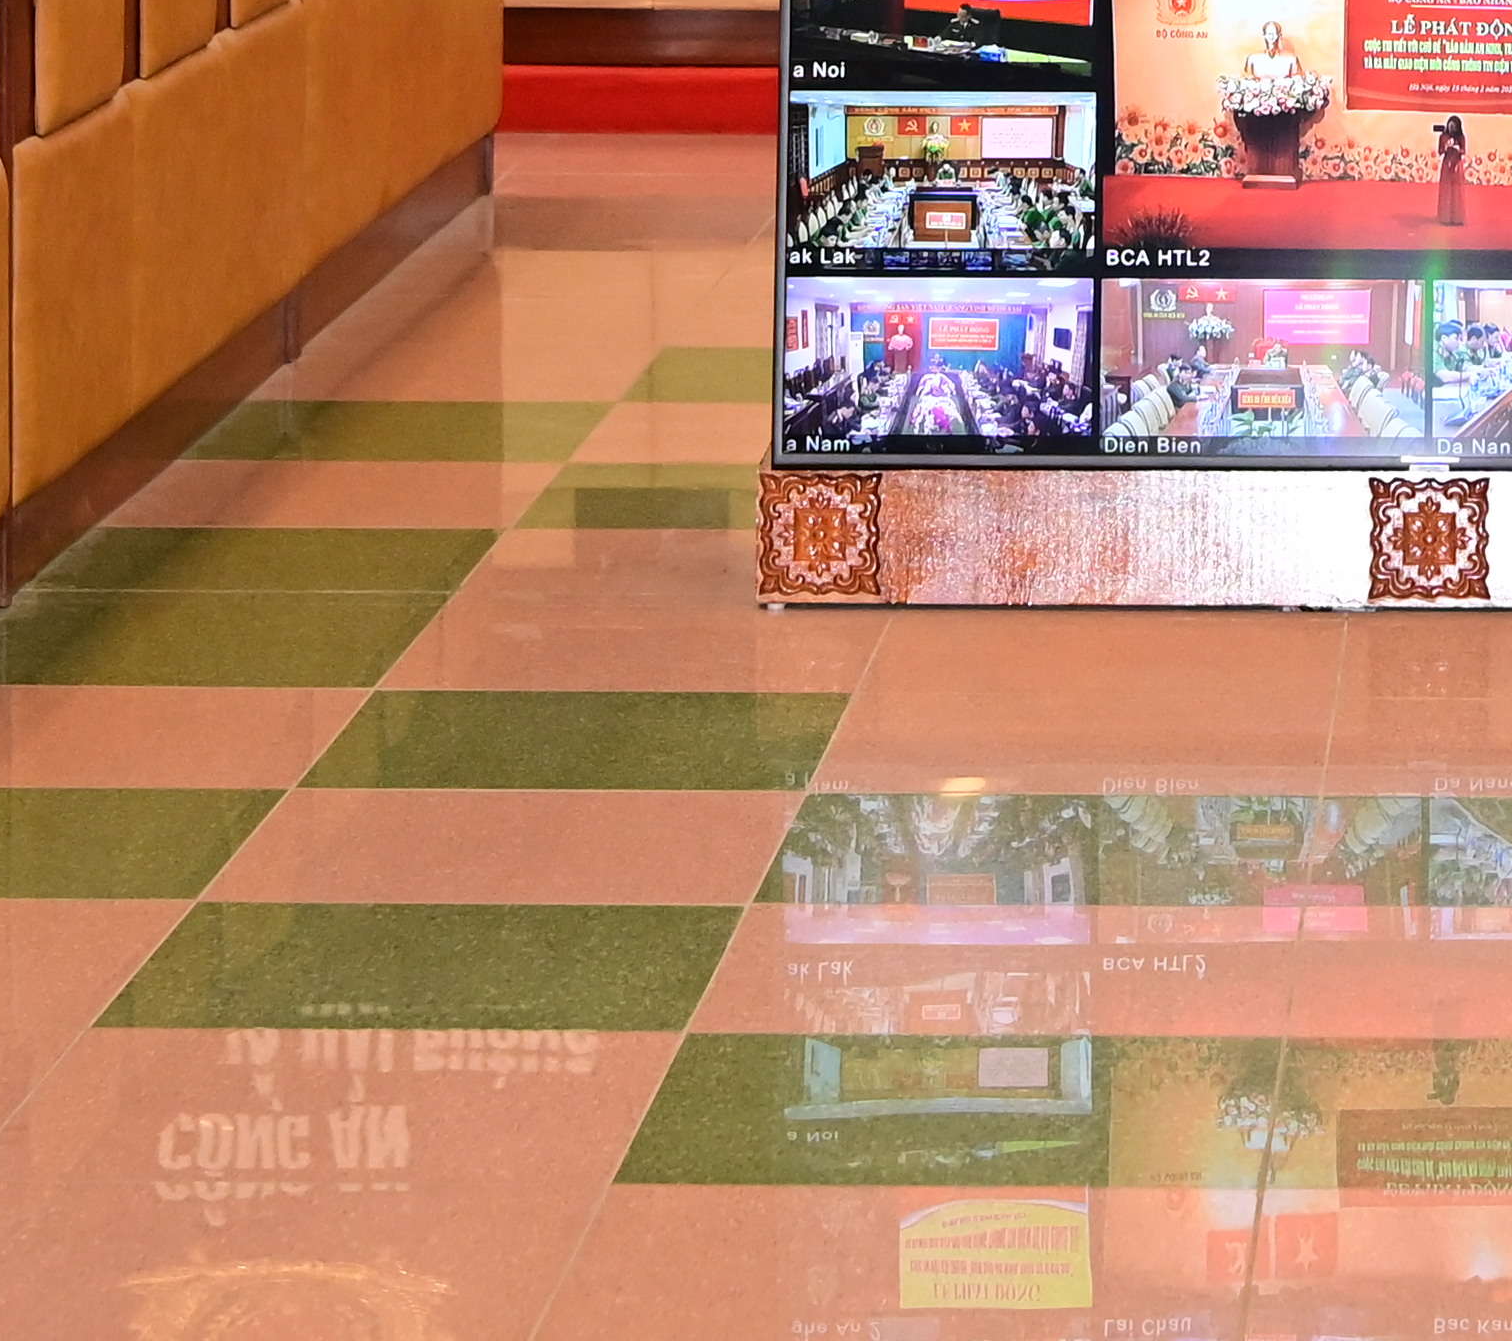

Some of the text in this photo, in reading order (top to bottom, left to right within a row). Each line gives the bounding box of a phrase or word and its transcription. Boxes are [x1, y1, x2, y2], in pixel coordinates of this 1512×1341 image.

[812, 61, 845, 78] Noi
[820, 248, 856, 265] Lak
[1106, 248, 1210, 267] BCA HTL2
[806, 435, 850, 451] Nam
[1104, 434, 1201, 453] Dien Bien
[1436, 437, 1463, 455] Da
